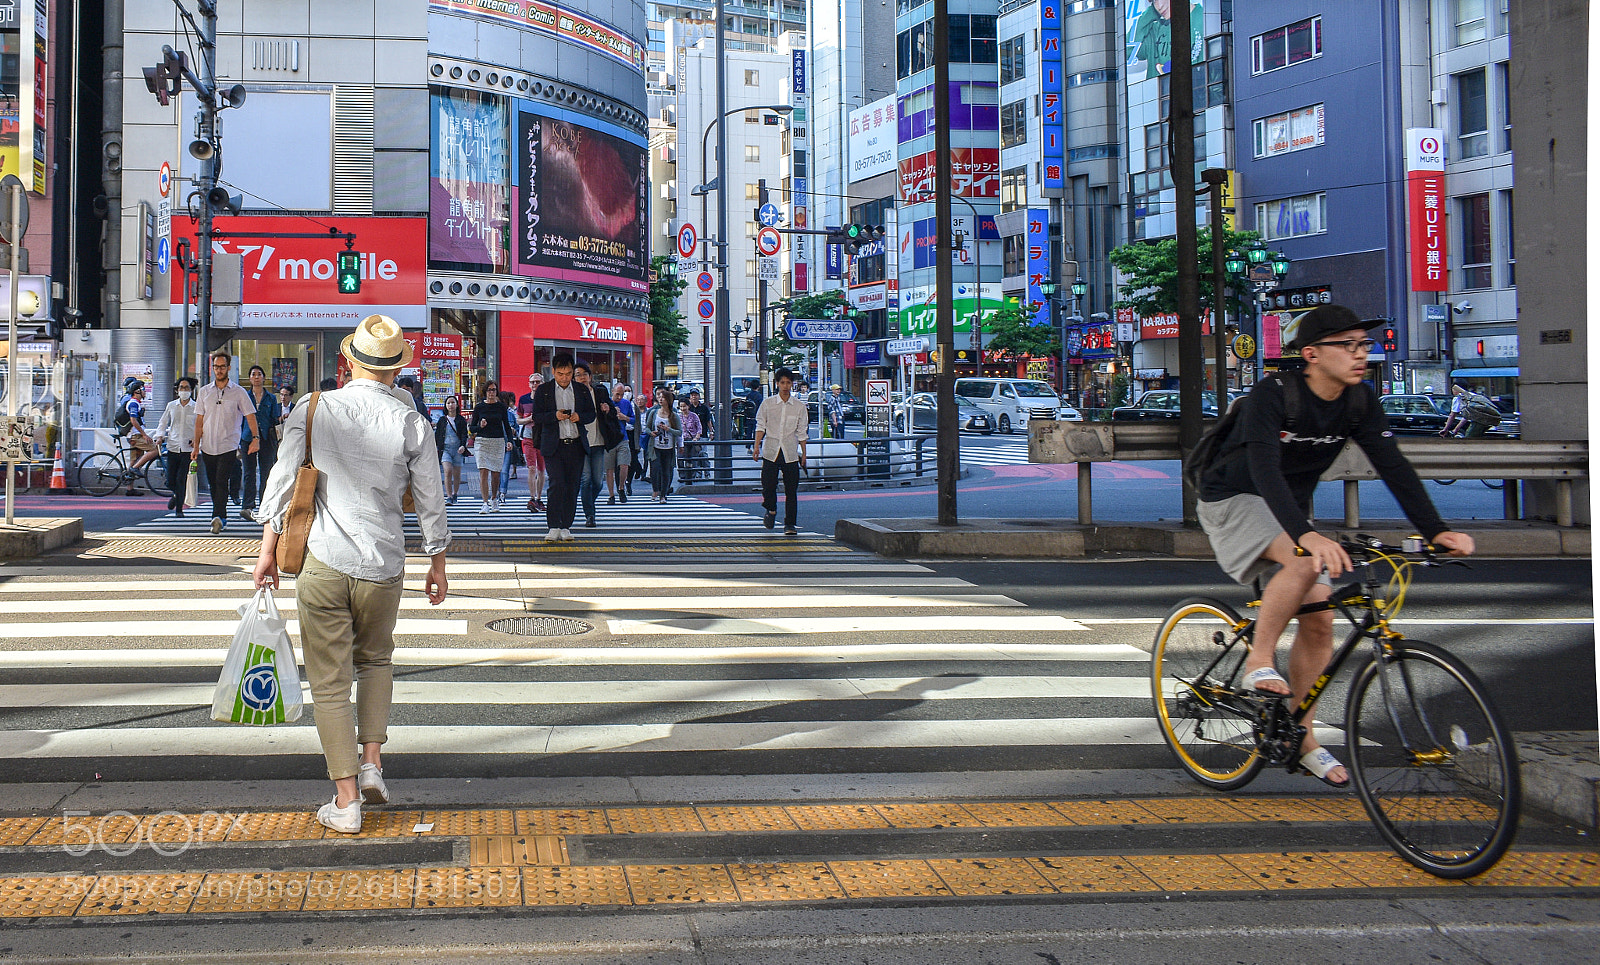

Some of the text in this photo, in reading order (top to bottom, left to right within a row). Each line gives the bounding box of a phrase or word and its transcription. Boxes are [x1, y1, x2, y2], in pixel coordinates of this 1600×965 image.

[528, 6, 556, 25] Comic
[449, 116, 486, 138] 龍角散
[850, 104, 895, 137] 広告募集
[551, 122, 582, 143] KOBE
[854, 149, 891, 172] 03-5774-7506
[902, 165, 936, 182] キャッシング
[449, 197, 486, 219] 龍角散
[444, 218, 491, 239] ダイレクト
[1424, 179, 1440, 280] 三菱UFJ銀行
[579, 235, 626, 258] 03-5775-6633
[679, 261, 697, 270] ここから
[1029, 220, 1044, 314] カラオケ
[306, 311, 338, 319] Internet
[341, 311, 359, 319] Park
[796, 324, 807, 333] 412
[808, 323, 850, 333] 六本木通り
